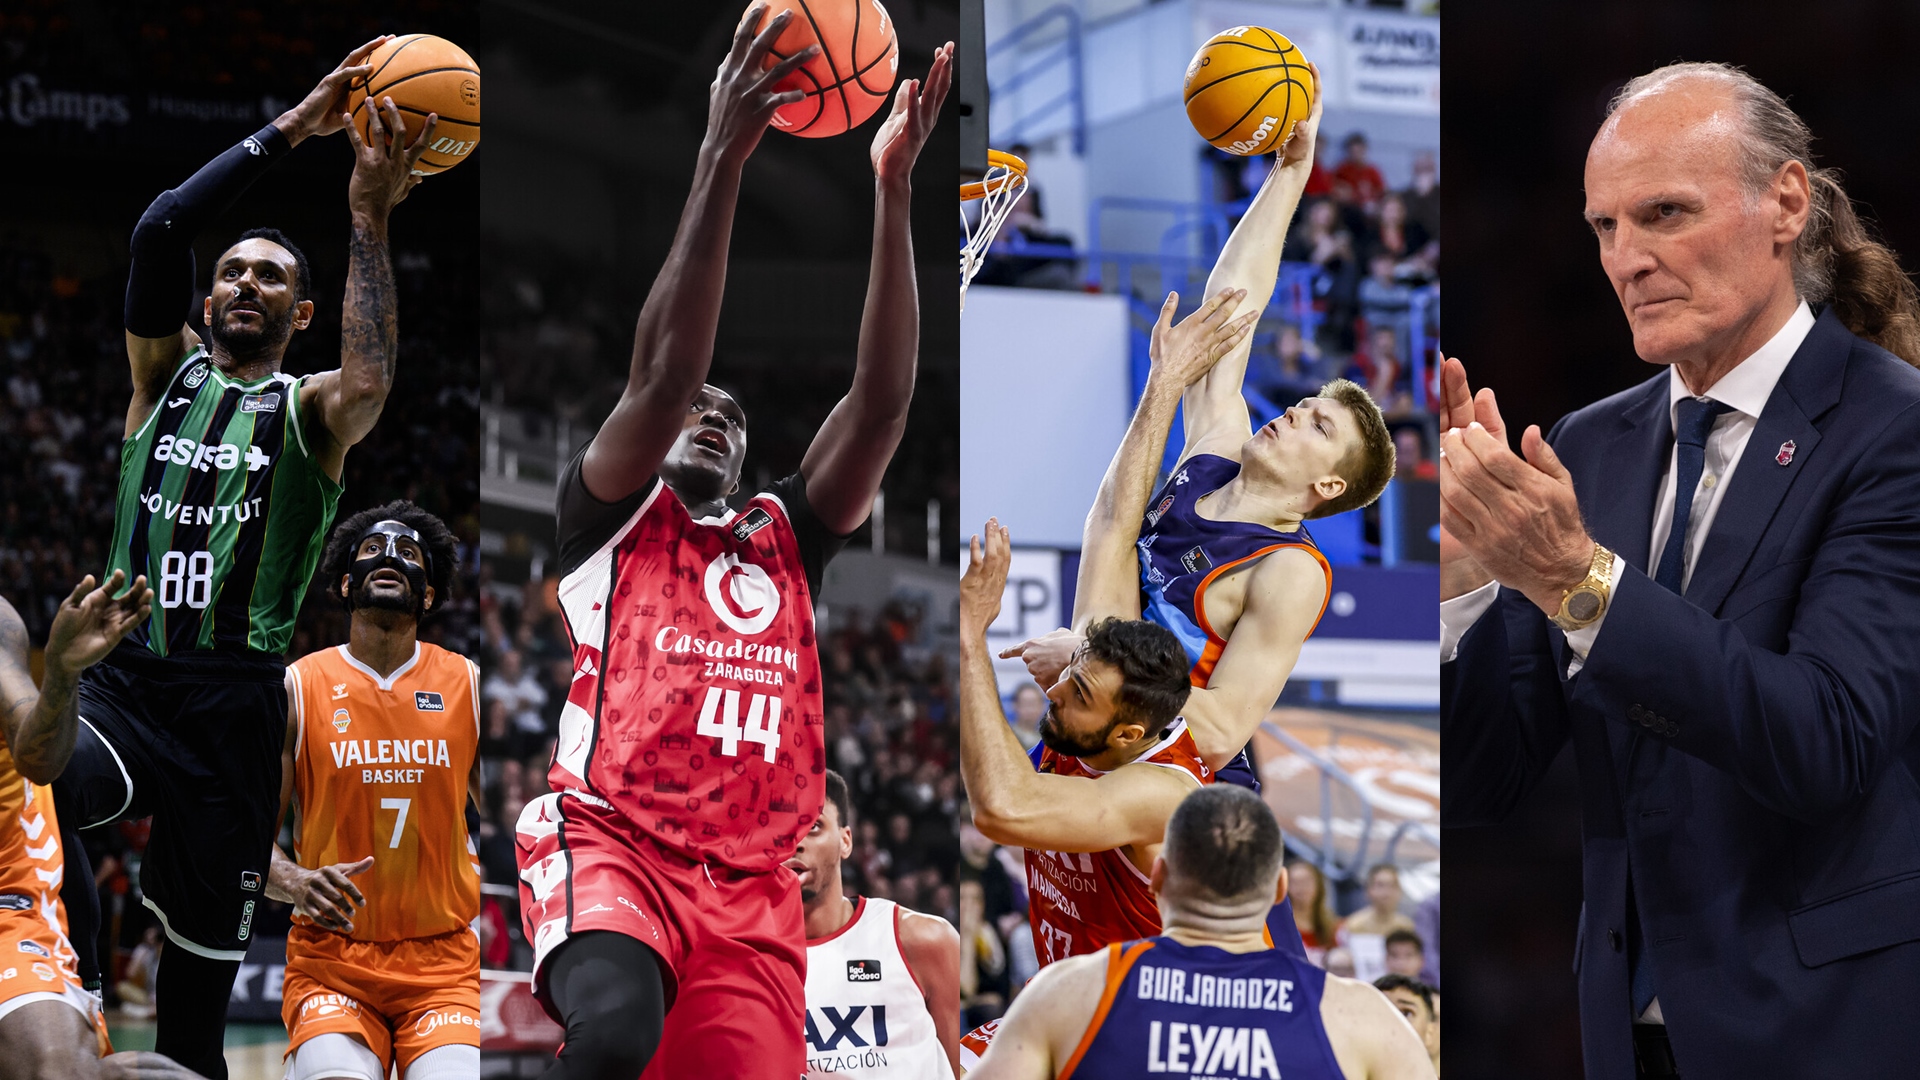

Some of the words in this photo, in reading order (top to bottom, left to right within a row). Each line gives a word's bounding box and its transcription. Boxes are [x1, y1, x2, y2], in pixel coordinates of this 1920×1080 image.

[140, 486, 262, 525] JOVENTUT
[159, 551, 214, 609] 88
[655, 626, 799, 674] Casademt
[704, 662, 783, 687] ZARAGOZA
[696, 686, 783, 765] 44
[329, 739, 451, 769] VALENCIA
[362, 769, 425, 783] BASKET
[380, 798, 411, 848] 7
[243, 879, 257, 889] acb
[1024, 847, 1098, 893] ATIZACIÓN
[1030, 864, 1082, 922] MANRESA
[849, 966, 864, 974] liga
[1137, 965, 1294, 1013] BURJANADZE
[301, 994, 358, 1017] PULEVA
[807, 1049, 888, 1073] TIZACIÓN
[1147, 1020, 1282, 1080] LEYMA
